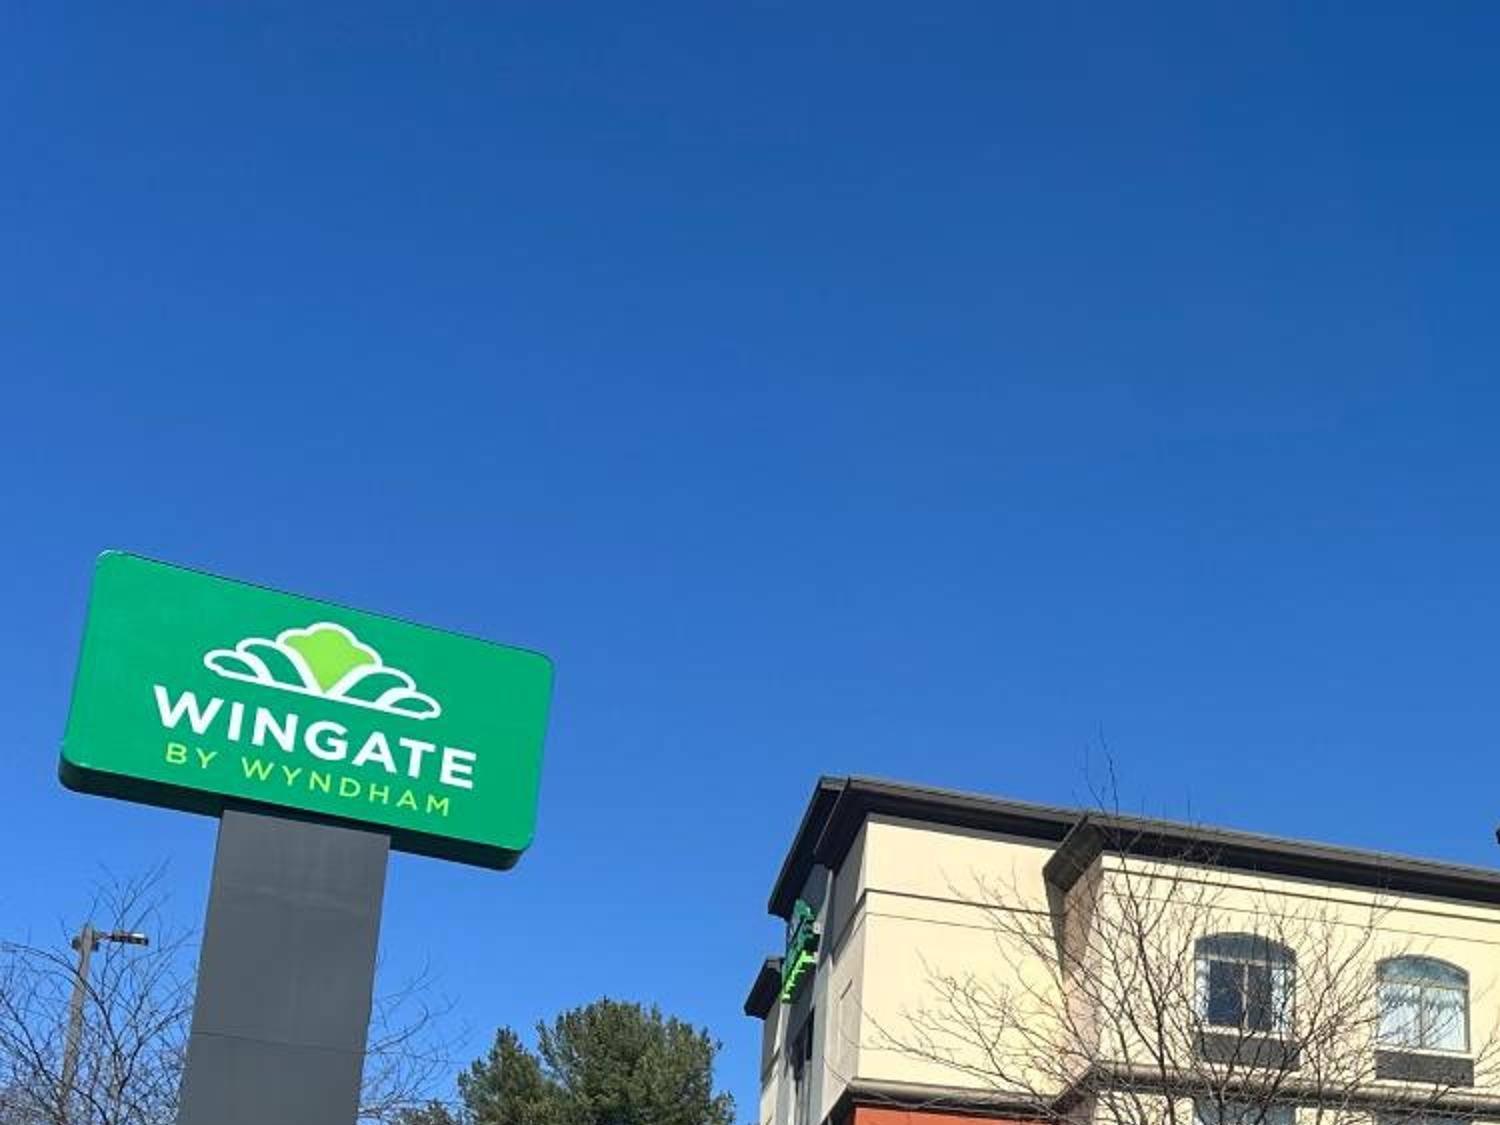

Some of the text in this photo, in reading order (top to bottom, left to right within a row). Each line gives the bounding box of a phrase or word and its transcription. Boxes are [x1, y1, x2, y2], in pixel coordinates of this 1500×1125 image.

[153, 684, 476, 789] WINGATE
[166, 743, 450, 817] BY WYNDHAM
